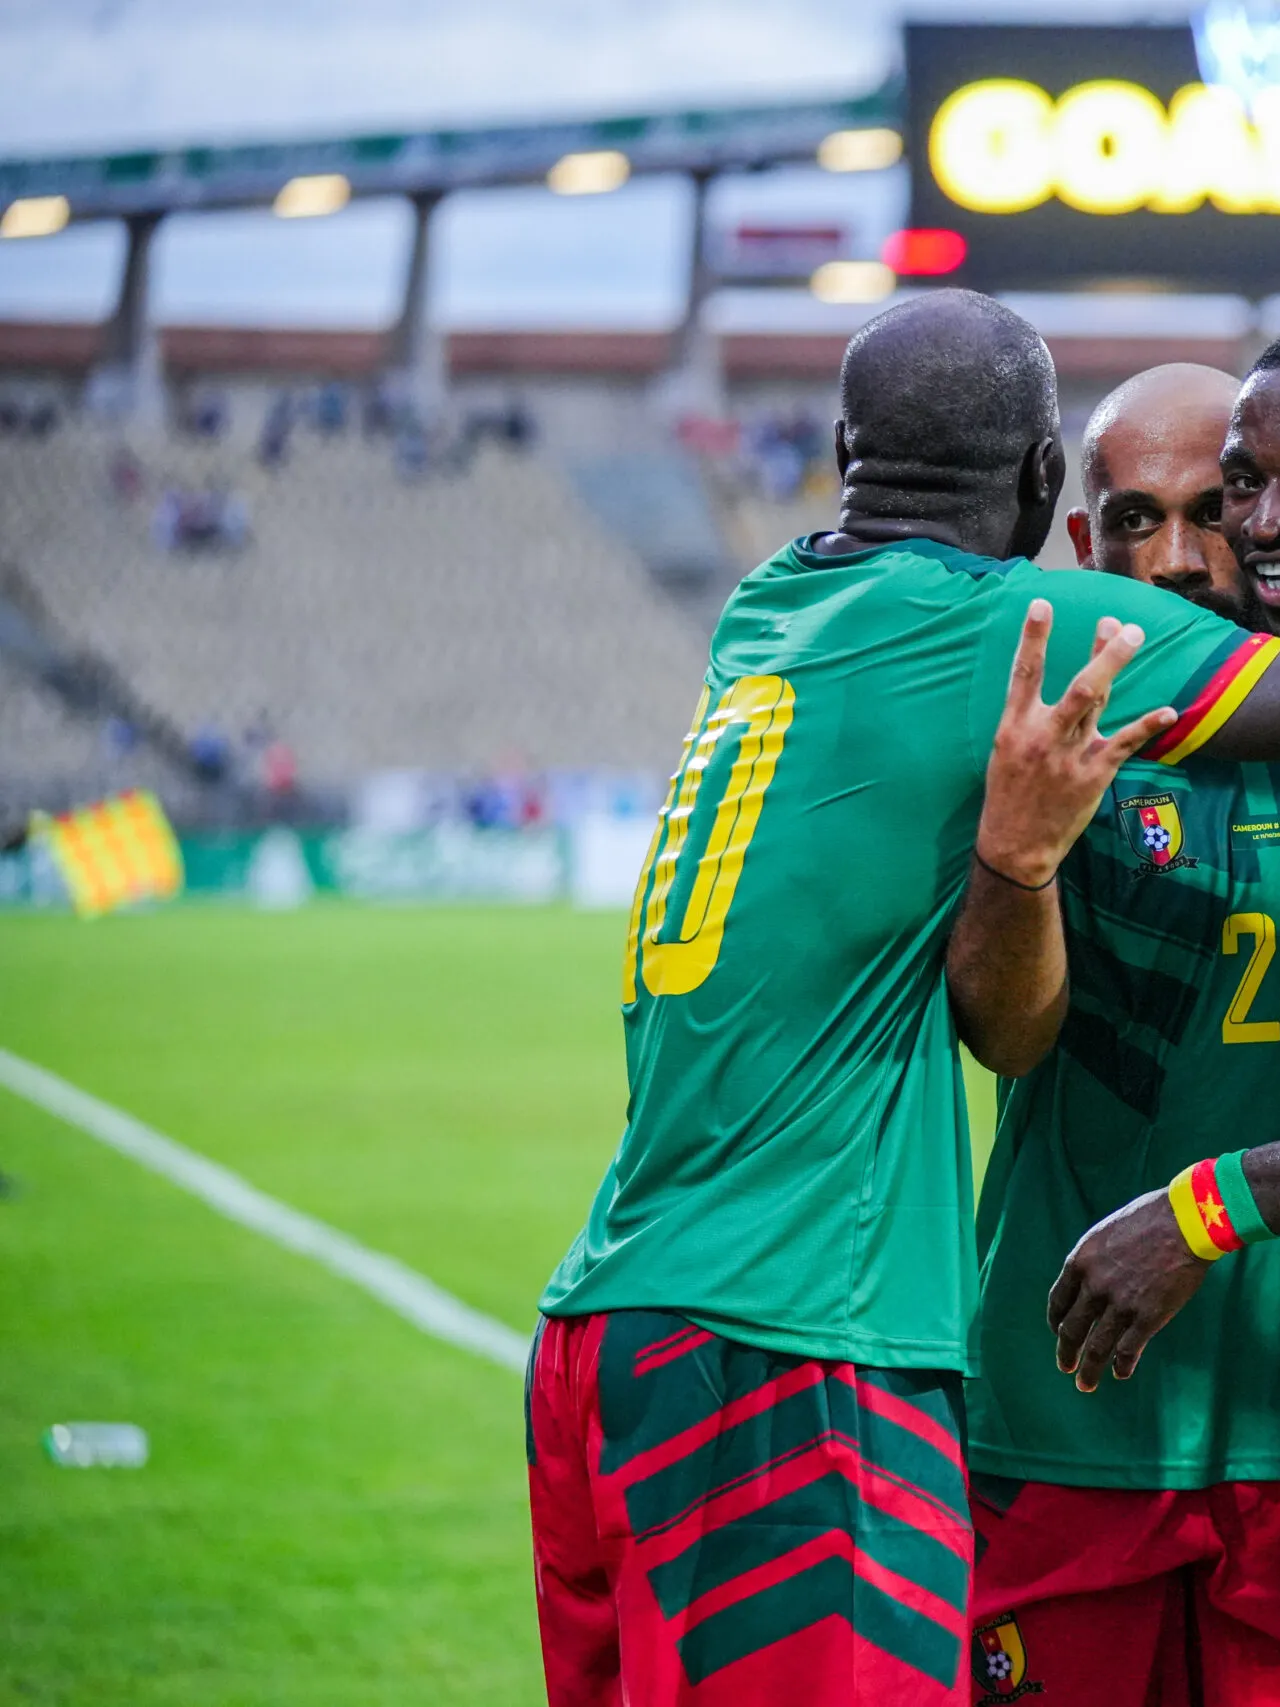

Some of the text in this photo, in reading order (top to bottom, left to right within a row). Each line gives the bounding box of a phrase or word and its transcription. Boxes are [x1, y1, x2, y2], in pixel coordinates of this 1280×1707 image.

[1121, 796, 1170, 808] CAMEROUN
[1232, 823, 1273, 832] CAMEROUN
[622, 675, 796, 1004] 10
